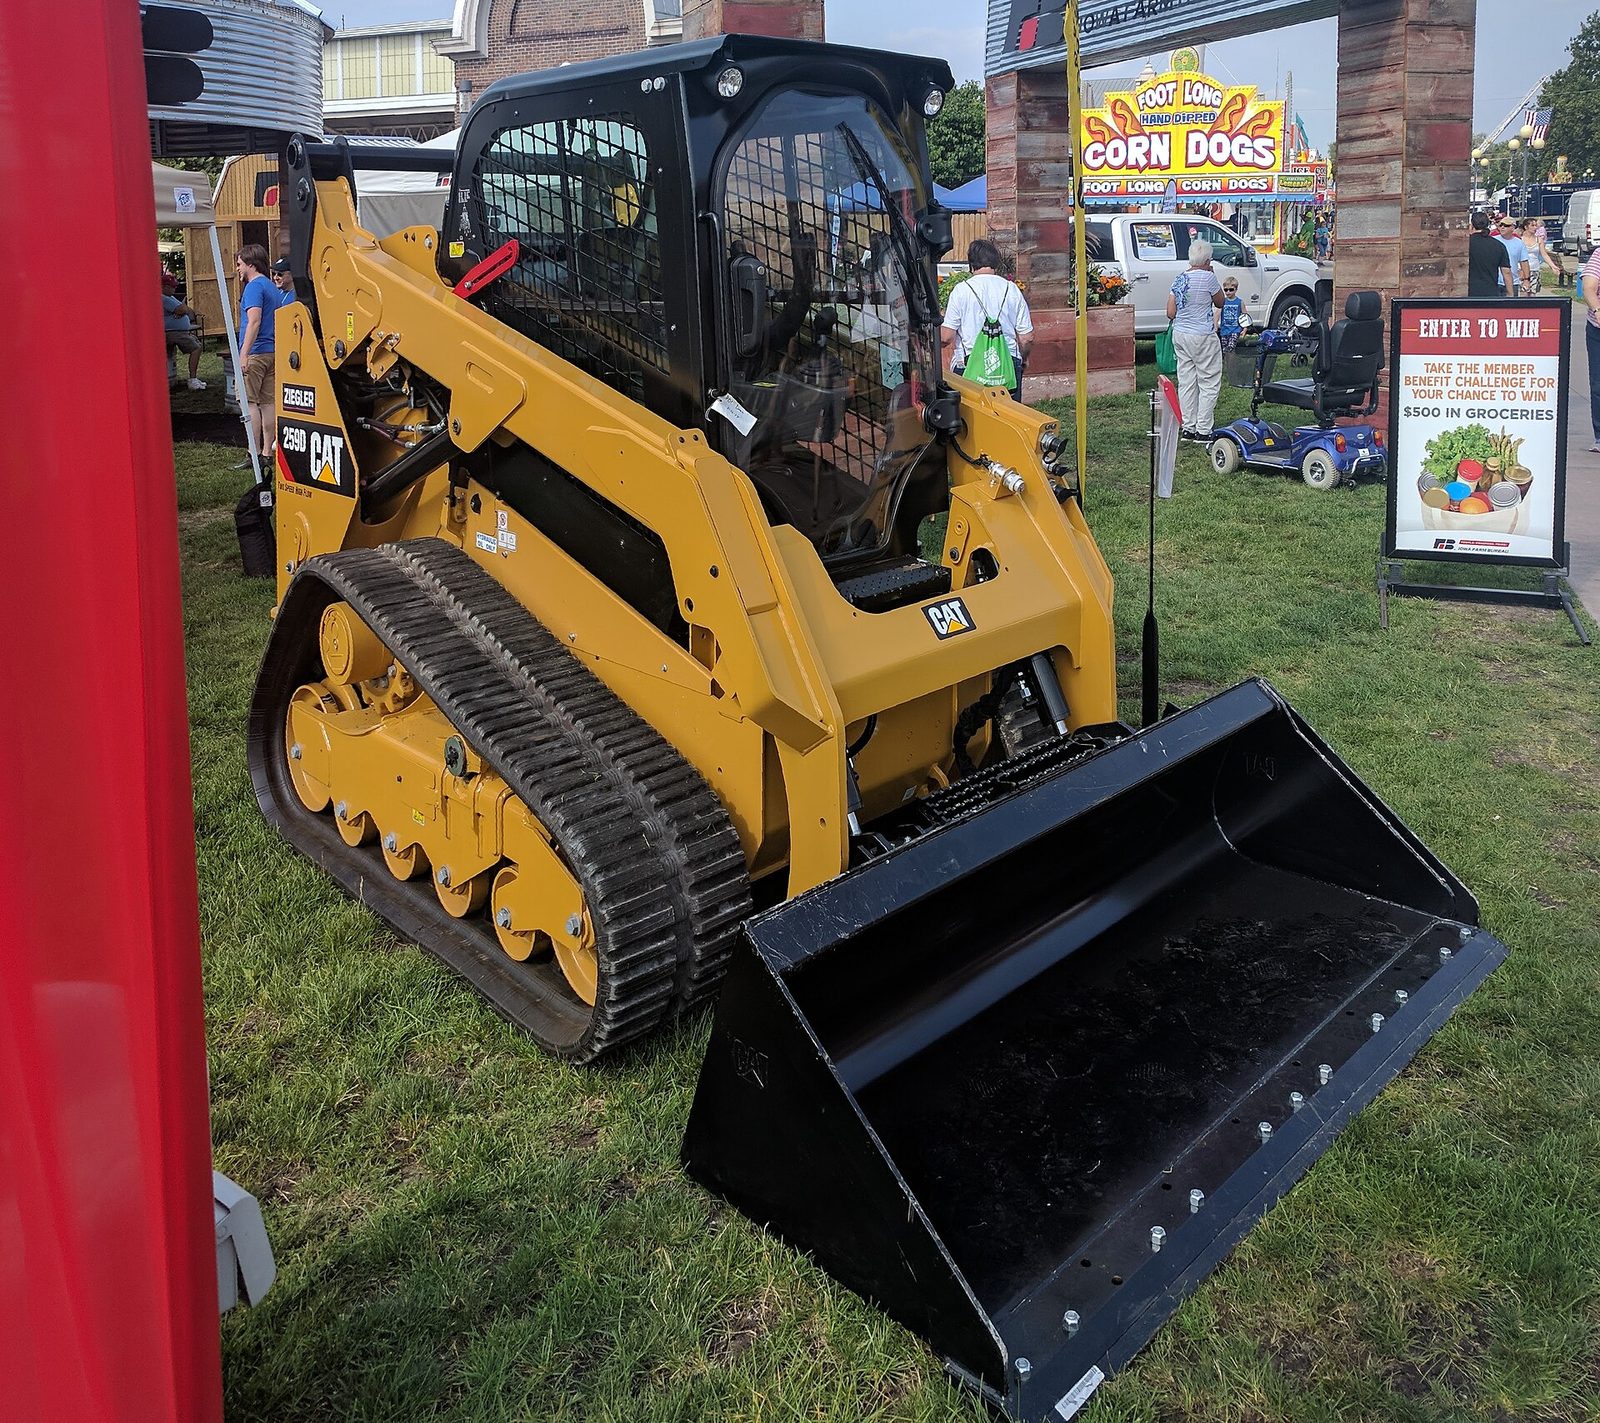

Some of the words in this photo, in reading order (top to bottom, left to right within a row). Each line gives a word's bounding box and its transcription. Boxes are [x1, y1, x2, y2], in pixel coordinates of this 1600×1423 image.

[1136, 80, 1178, 110] FOOT
[1183, 80, 1223, 108] LONG
[1140, 112, 1173, 126] HAND
[1083, 131, 1171, 173] CORN
[1185, 130, 1276, 170] DOGS
[1083, 181, 1121, 194] FOOT
[1126, 181, 1165, 193] LONG
[1181, 179, 1223, 192] CORN
[1228, 178, 1268, 191] DOGS
[1419, 319, 1471, 338] ENTER
[1478, 318, 1498, 338] TO
[1505, 319, 1540, 338] WIN
[1424, 363, 1453, 374] TAKE
[1457, 363, 1480, 374] THE
[1484, 364, 1535, 375] MEMBER
[1404, 376, 1451, 387] BENEFIT
[1455, 376, 1526, 388] CHALLENGE
[1530, 377, 1555, 389] FOR
[284, 388, 314, 408] ZIEGLER
[1412, 389, 1443, 400] YOUR
[1447, 390, 1496, 401] CHANCE
[1501, 390, 1517, 401] TO
[1521, 391, 1547, 402] WIN
[1403, 406, 1441, 418] $500
[1446, 408, 1461, 418] IN
[1466, 408, 1554, 421] GROCERIES
[283, 426, 306, 453] 259D
[310, 431, 343, 486] CAT
[928, 600, 970, 635] CAT
